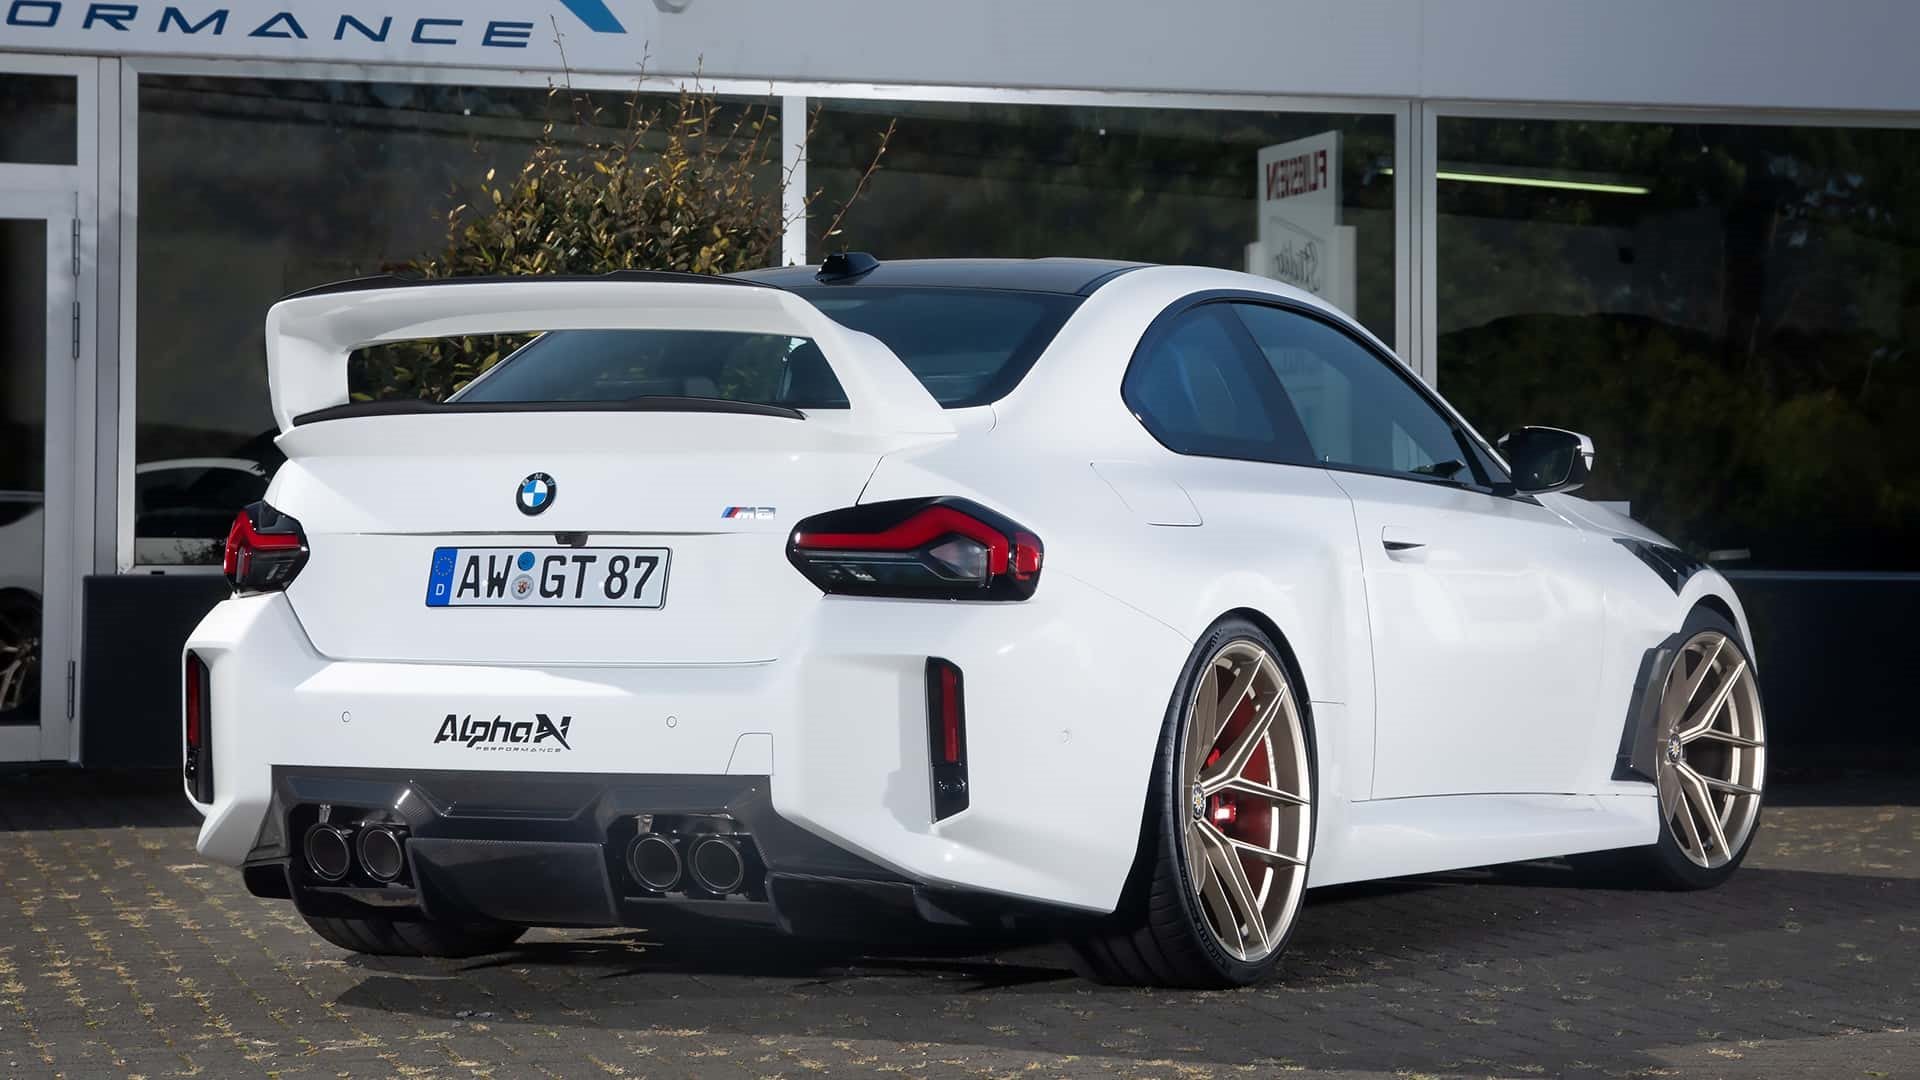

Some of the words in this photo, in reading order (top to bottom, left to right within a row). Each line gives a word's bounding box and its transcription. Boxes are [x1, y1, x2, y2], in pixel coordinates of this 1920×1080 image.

[435, 583, 445, 596] D
[456, 556, 513, 599] AW
[539, 556, 597, 599] GT
[603, 556, 659, 600] 87
